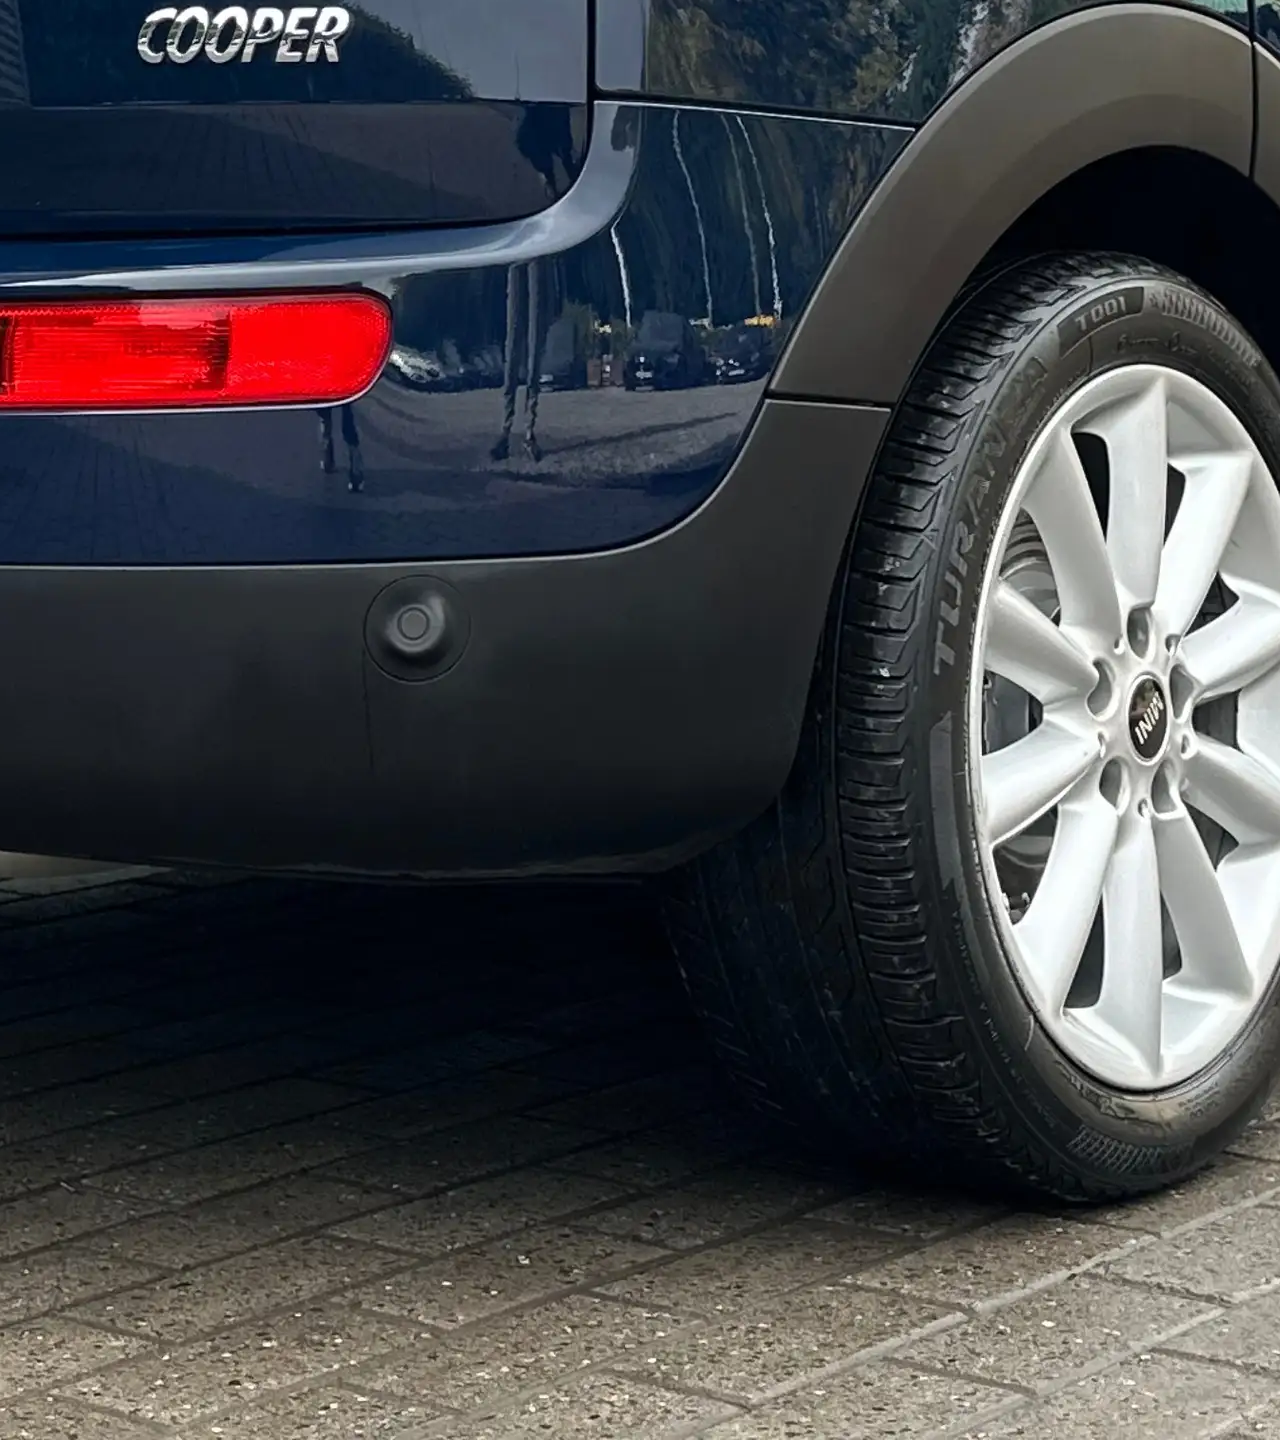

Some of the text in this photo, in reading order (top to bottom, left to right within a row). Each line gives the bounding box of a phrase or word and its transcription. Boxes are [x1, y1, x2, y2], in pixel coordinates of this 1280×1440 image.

[137, 6, 351, 64] COOPER
[1075, 296, 1127, 331] T001
[1134, 691, 1164, 745] MINI
